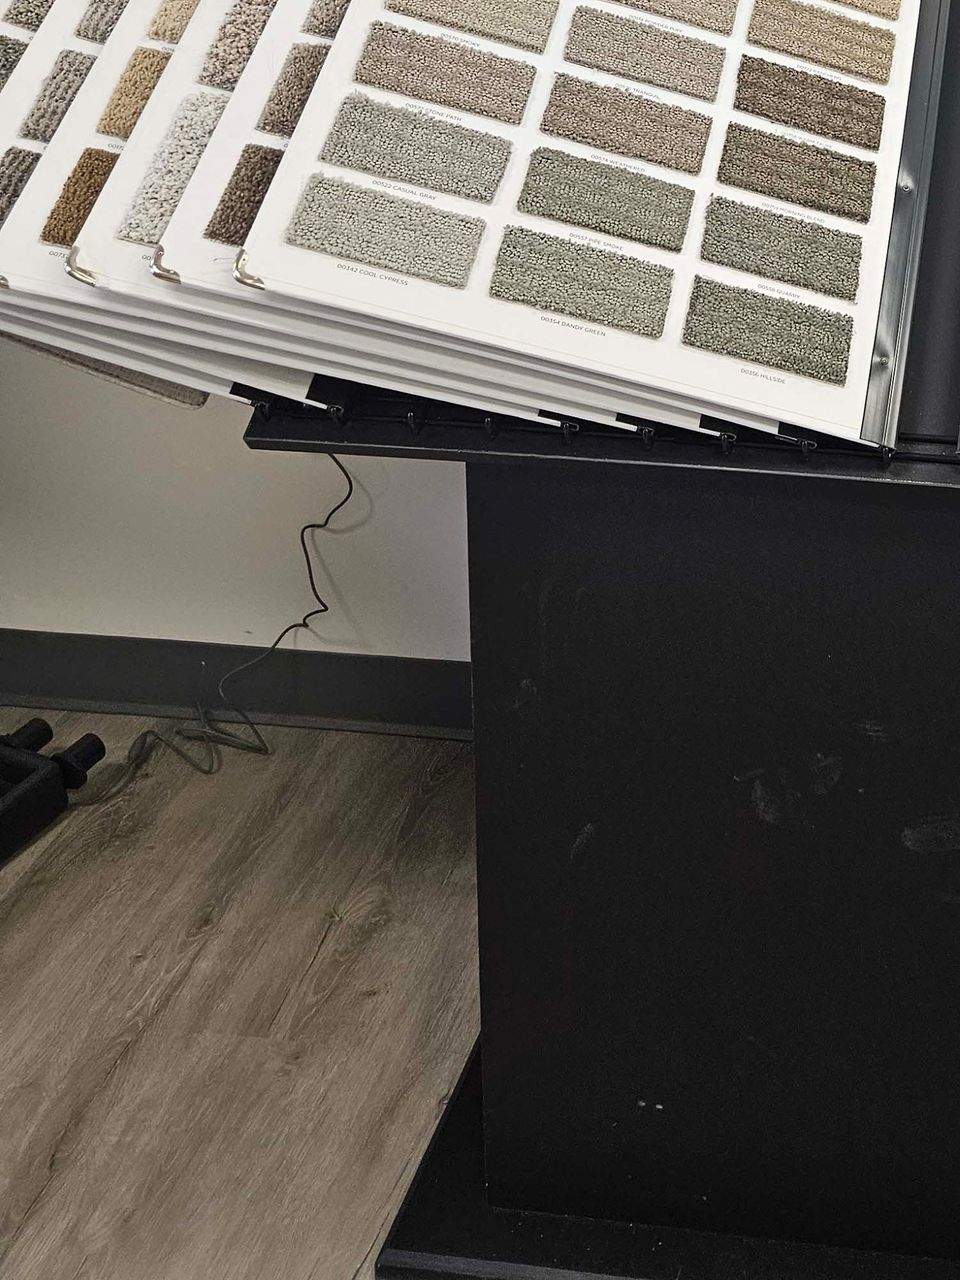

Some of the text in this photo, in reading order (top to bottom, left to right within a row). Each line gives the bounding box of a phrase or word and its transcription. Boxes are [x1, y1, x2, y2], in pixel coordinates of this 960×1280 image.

[392, 185, 418, 196] CASUAL
[420, 192, 436, 200] GRAY
[359, 269, 377, 278] COOL
[379, 273, 409, 286] CYPRESS
[561, 321, 583, 331] DANDY
[584, 326, 606, 337] GREEN
[760, 373, 786, 384] HILLSIDE
